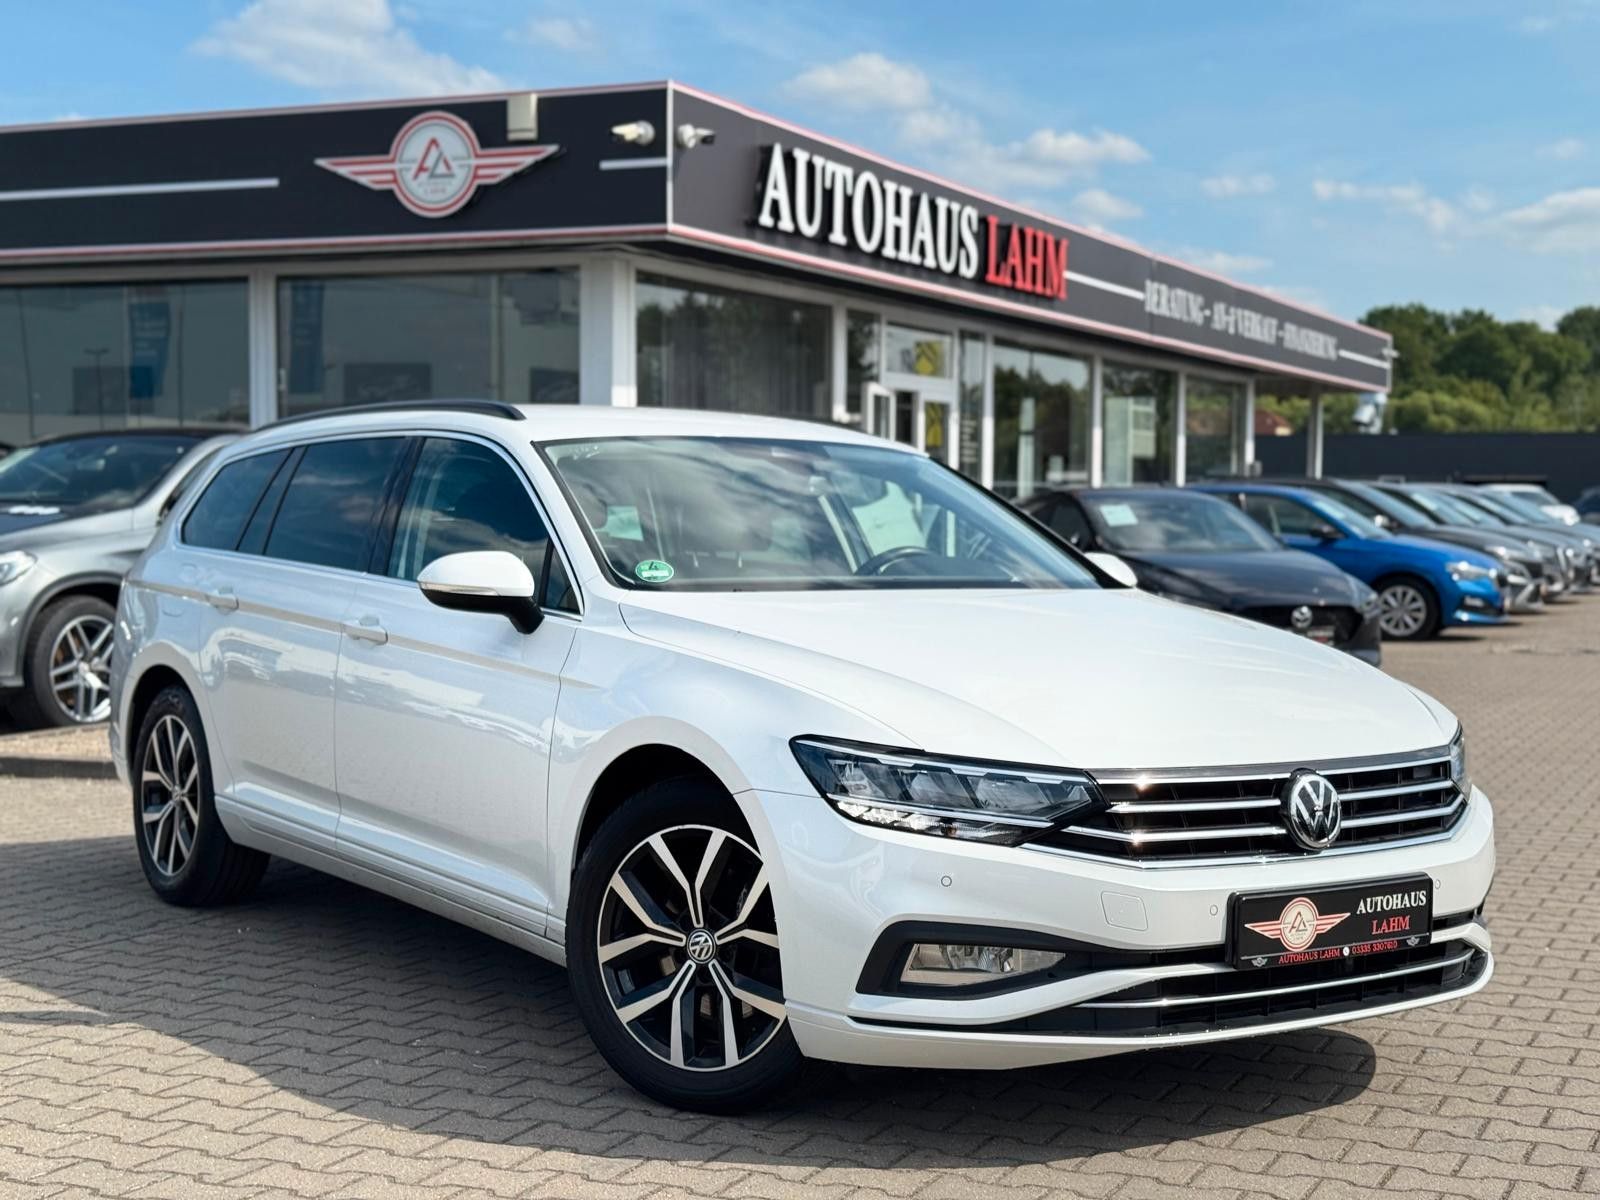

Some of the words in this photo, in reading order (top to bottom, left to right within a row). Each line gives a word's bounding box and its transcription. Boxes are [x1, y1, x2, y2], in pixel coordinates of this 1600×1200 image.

[758, 142, 979, 279] AUTOHAUS
[985, 215, 1069, 300] LAHM
[1356, 890, 1427, 915] AUTOHAUS
[1371, 915, 1411, 935] LAHM
[1278, 952, 1318, 964] AUTOHAUS
[1319, 948, 1340, 960] LAHM
